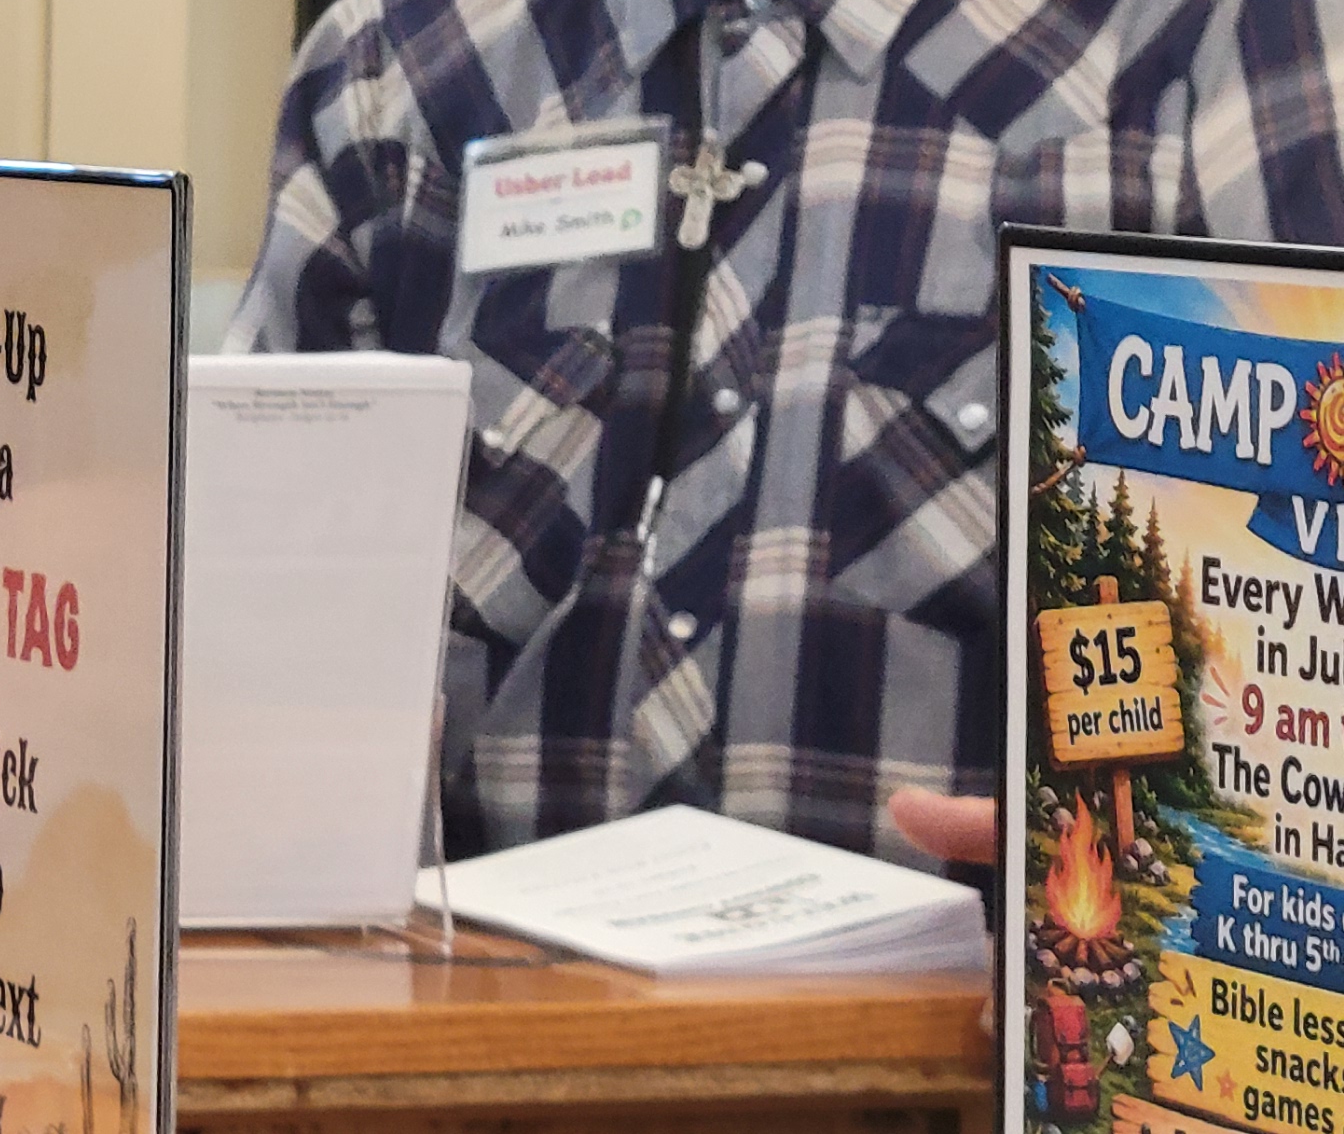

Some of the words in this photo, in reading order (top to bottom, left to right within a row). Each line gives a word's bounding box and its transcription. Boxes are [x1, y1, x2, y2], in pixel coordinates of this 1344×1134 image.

[1108, 333, 1298, 465] CAMP
[2, 566, 80, 672] TAG
[1200, 555, 1303, 630] Every
[1069, 625, 1142, 695] $15
[1256, 624, 1288, 677] in
[1298, 634, 1344, 686] Ju
[1067, 710, 1101, 744] per
[1107, 696, 1163, 735] child
[1241, 682, 1265, 736] 9
[1275, 703, 1330, 748] am
[1212, 741, 1271, 798] The
[1280, 754, 1344, 814] Cow
[1274, 811, 1301, 858] in
[1231, 873, 1274, 917] For
[1281, 884, 1337, 932] kids
[1217, 914, 1236, 953] K
[1243, 923, 1297, 968] thru
[1305, 934, 1341, 974] 5th
[1210, 976, 1285, 1032] Bible
[1242, 1084, 1335, 1134] games
